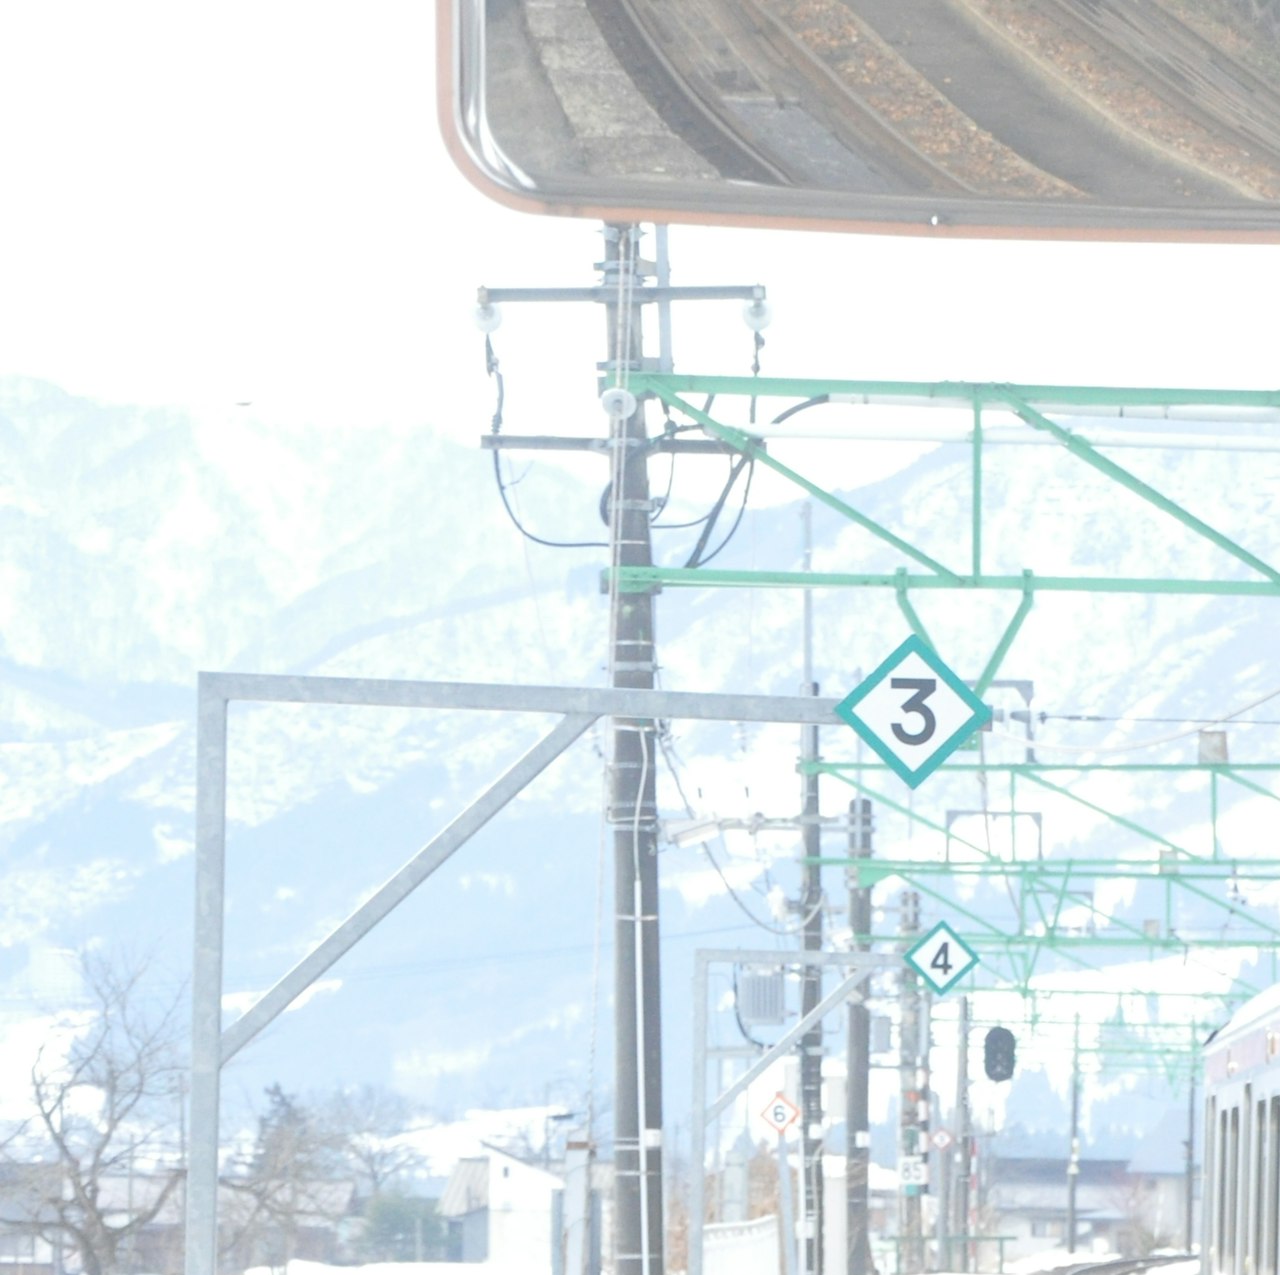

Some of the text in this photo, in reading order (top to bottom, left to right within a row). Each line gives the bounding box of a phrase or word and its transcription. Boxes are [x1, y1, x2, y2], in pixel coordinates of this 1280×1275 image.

[890, 678, 937, 746] 3
[931, 942, 953, 976] 4
[773, 1105, 786, 1123] 6
